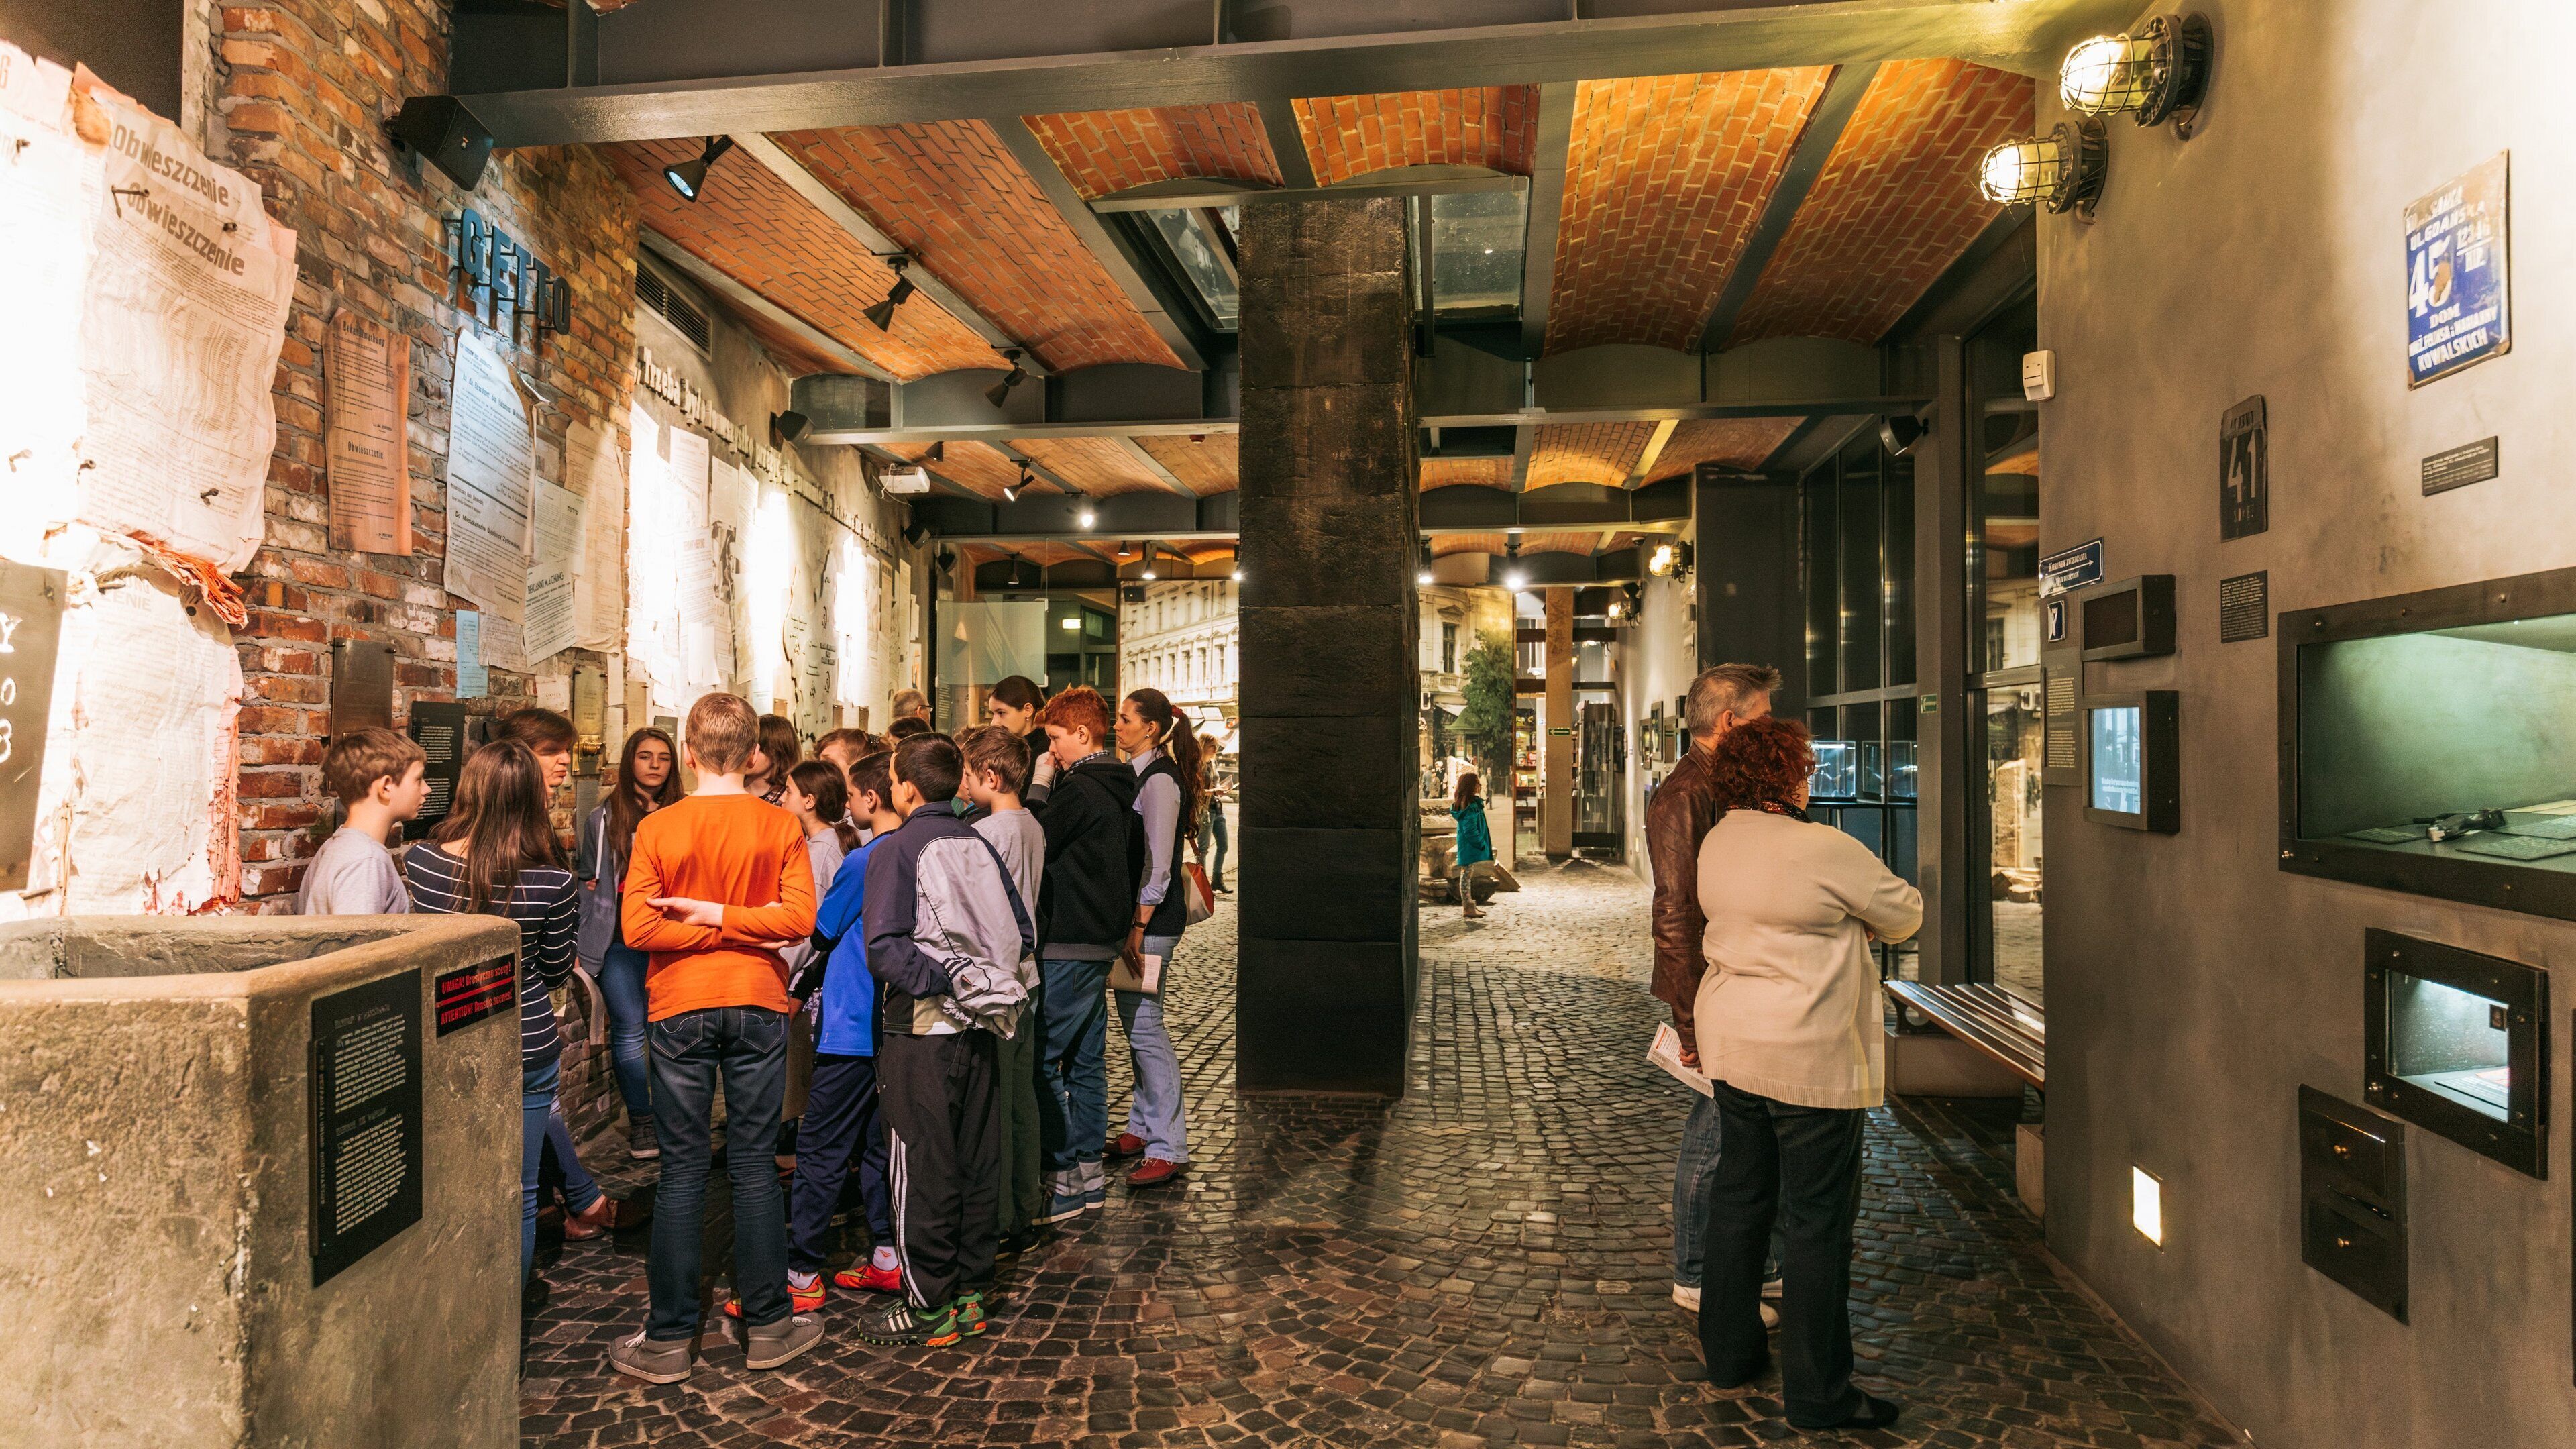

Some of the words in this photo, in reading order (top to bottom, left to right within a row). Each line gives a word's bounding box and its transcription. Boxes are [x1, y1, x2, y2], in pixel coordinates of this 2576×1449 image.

[113, 124, 229, 207] Obwieszczenie
[127, 182, 246, 276] Obwieszczenie
[461, 209, 570, 334] GETTO
[2408, 234, 2453, 318] 45
[2429, 303, 2461, 329] DOM
[2417, 327, 2489, 372] KOWALSKICH
[347, 441, 384, 459] Obwieszczenie
[2228, 429, 2255, 503] 41
[2051, 606, 2058, 637] 7
[441, 976, 465, 994] UWAGA!
[494, 962, 511, 977] sceny!
[441, 1003, 473, 1025] ATTENTION!
[474, 997, 493, 1013] Drastic
[493, 987, 513, 1006] scenes!
